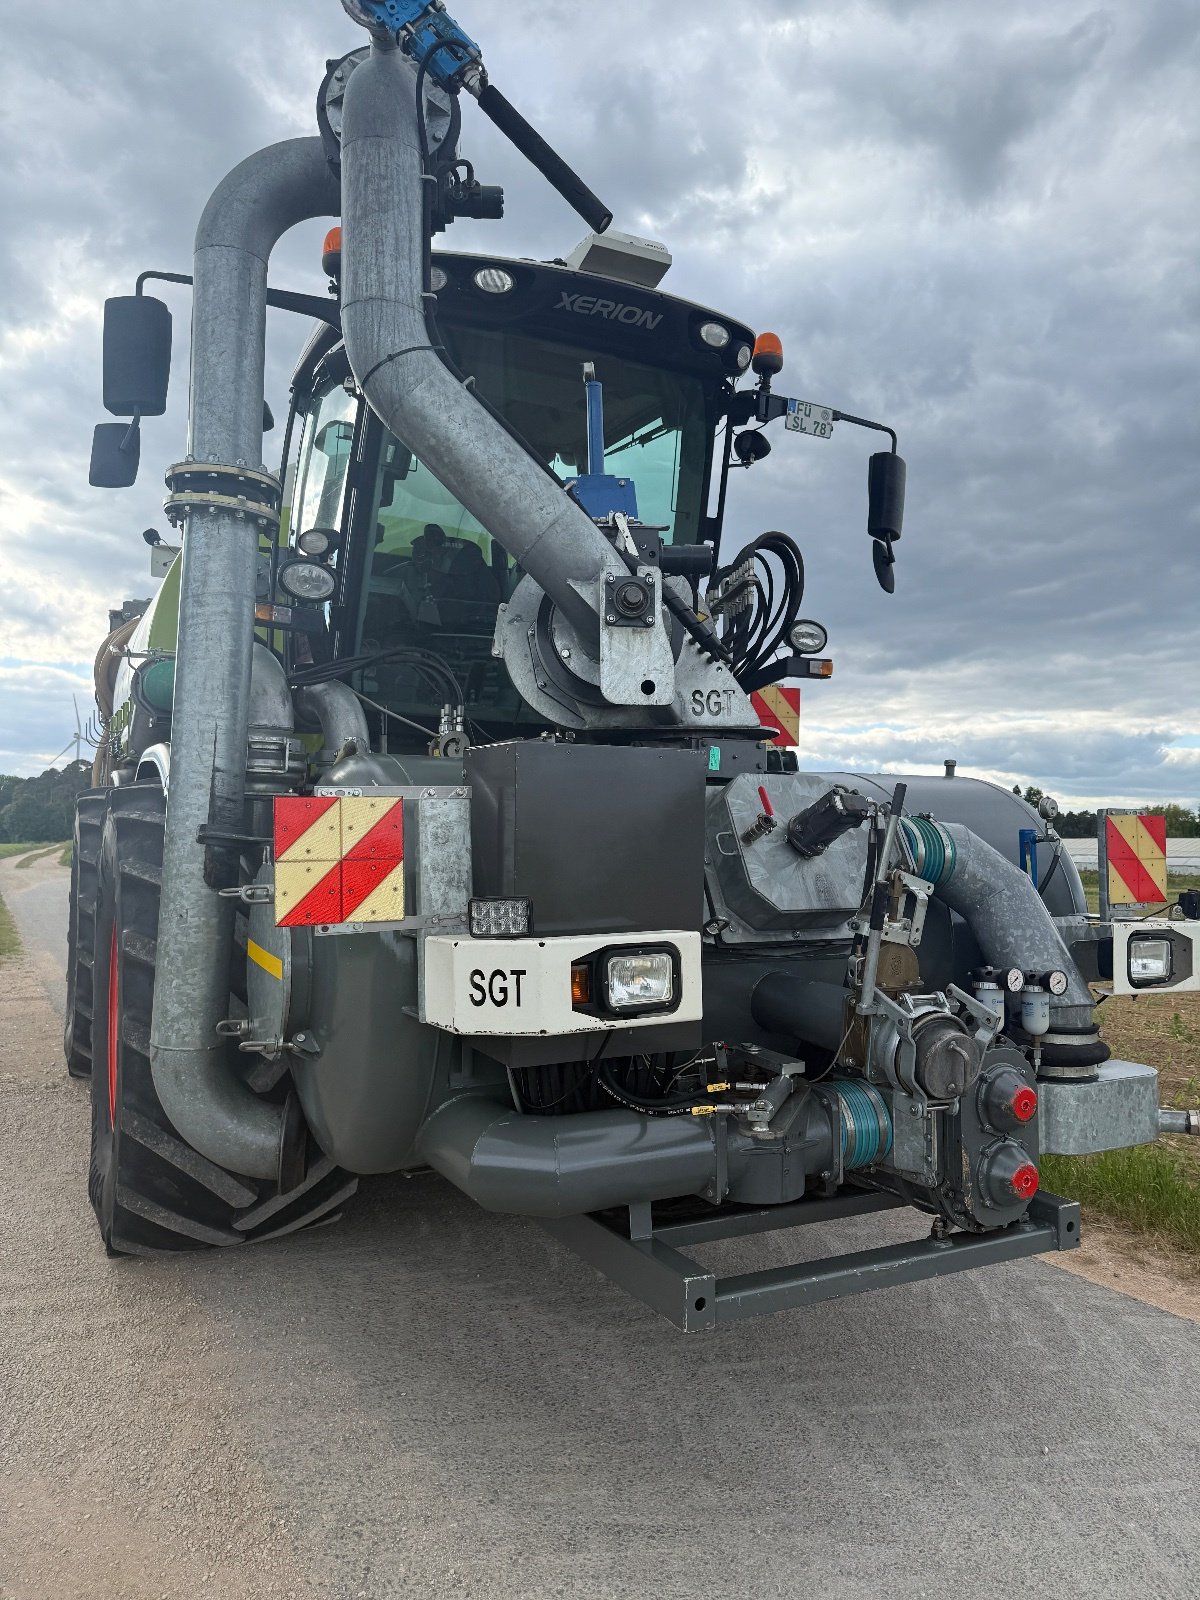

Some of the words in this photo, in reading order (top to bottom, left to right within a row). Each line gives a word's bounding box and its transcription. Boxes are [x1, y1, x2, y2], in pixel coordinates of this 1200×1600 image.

[553, 291, 664, 330] XERION
[797, 402, 812, 418] FÜ
[792, 415, 806, 432] SL
[813, 420, 827, 436] 78
[691, 689, 735, 717] SGT
[469, 968, 527, 1008] SGT
